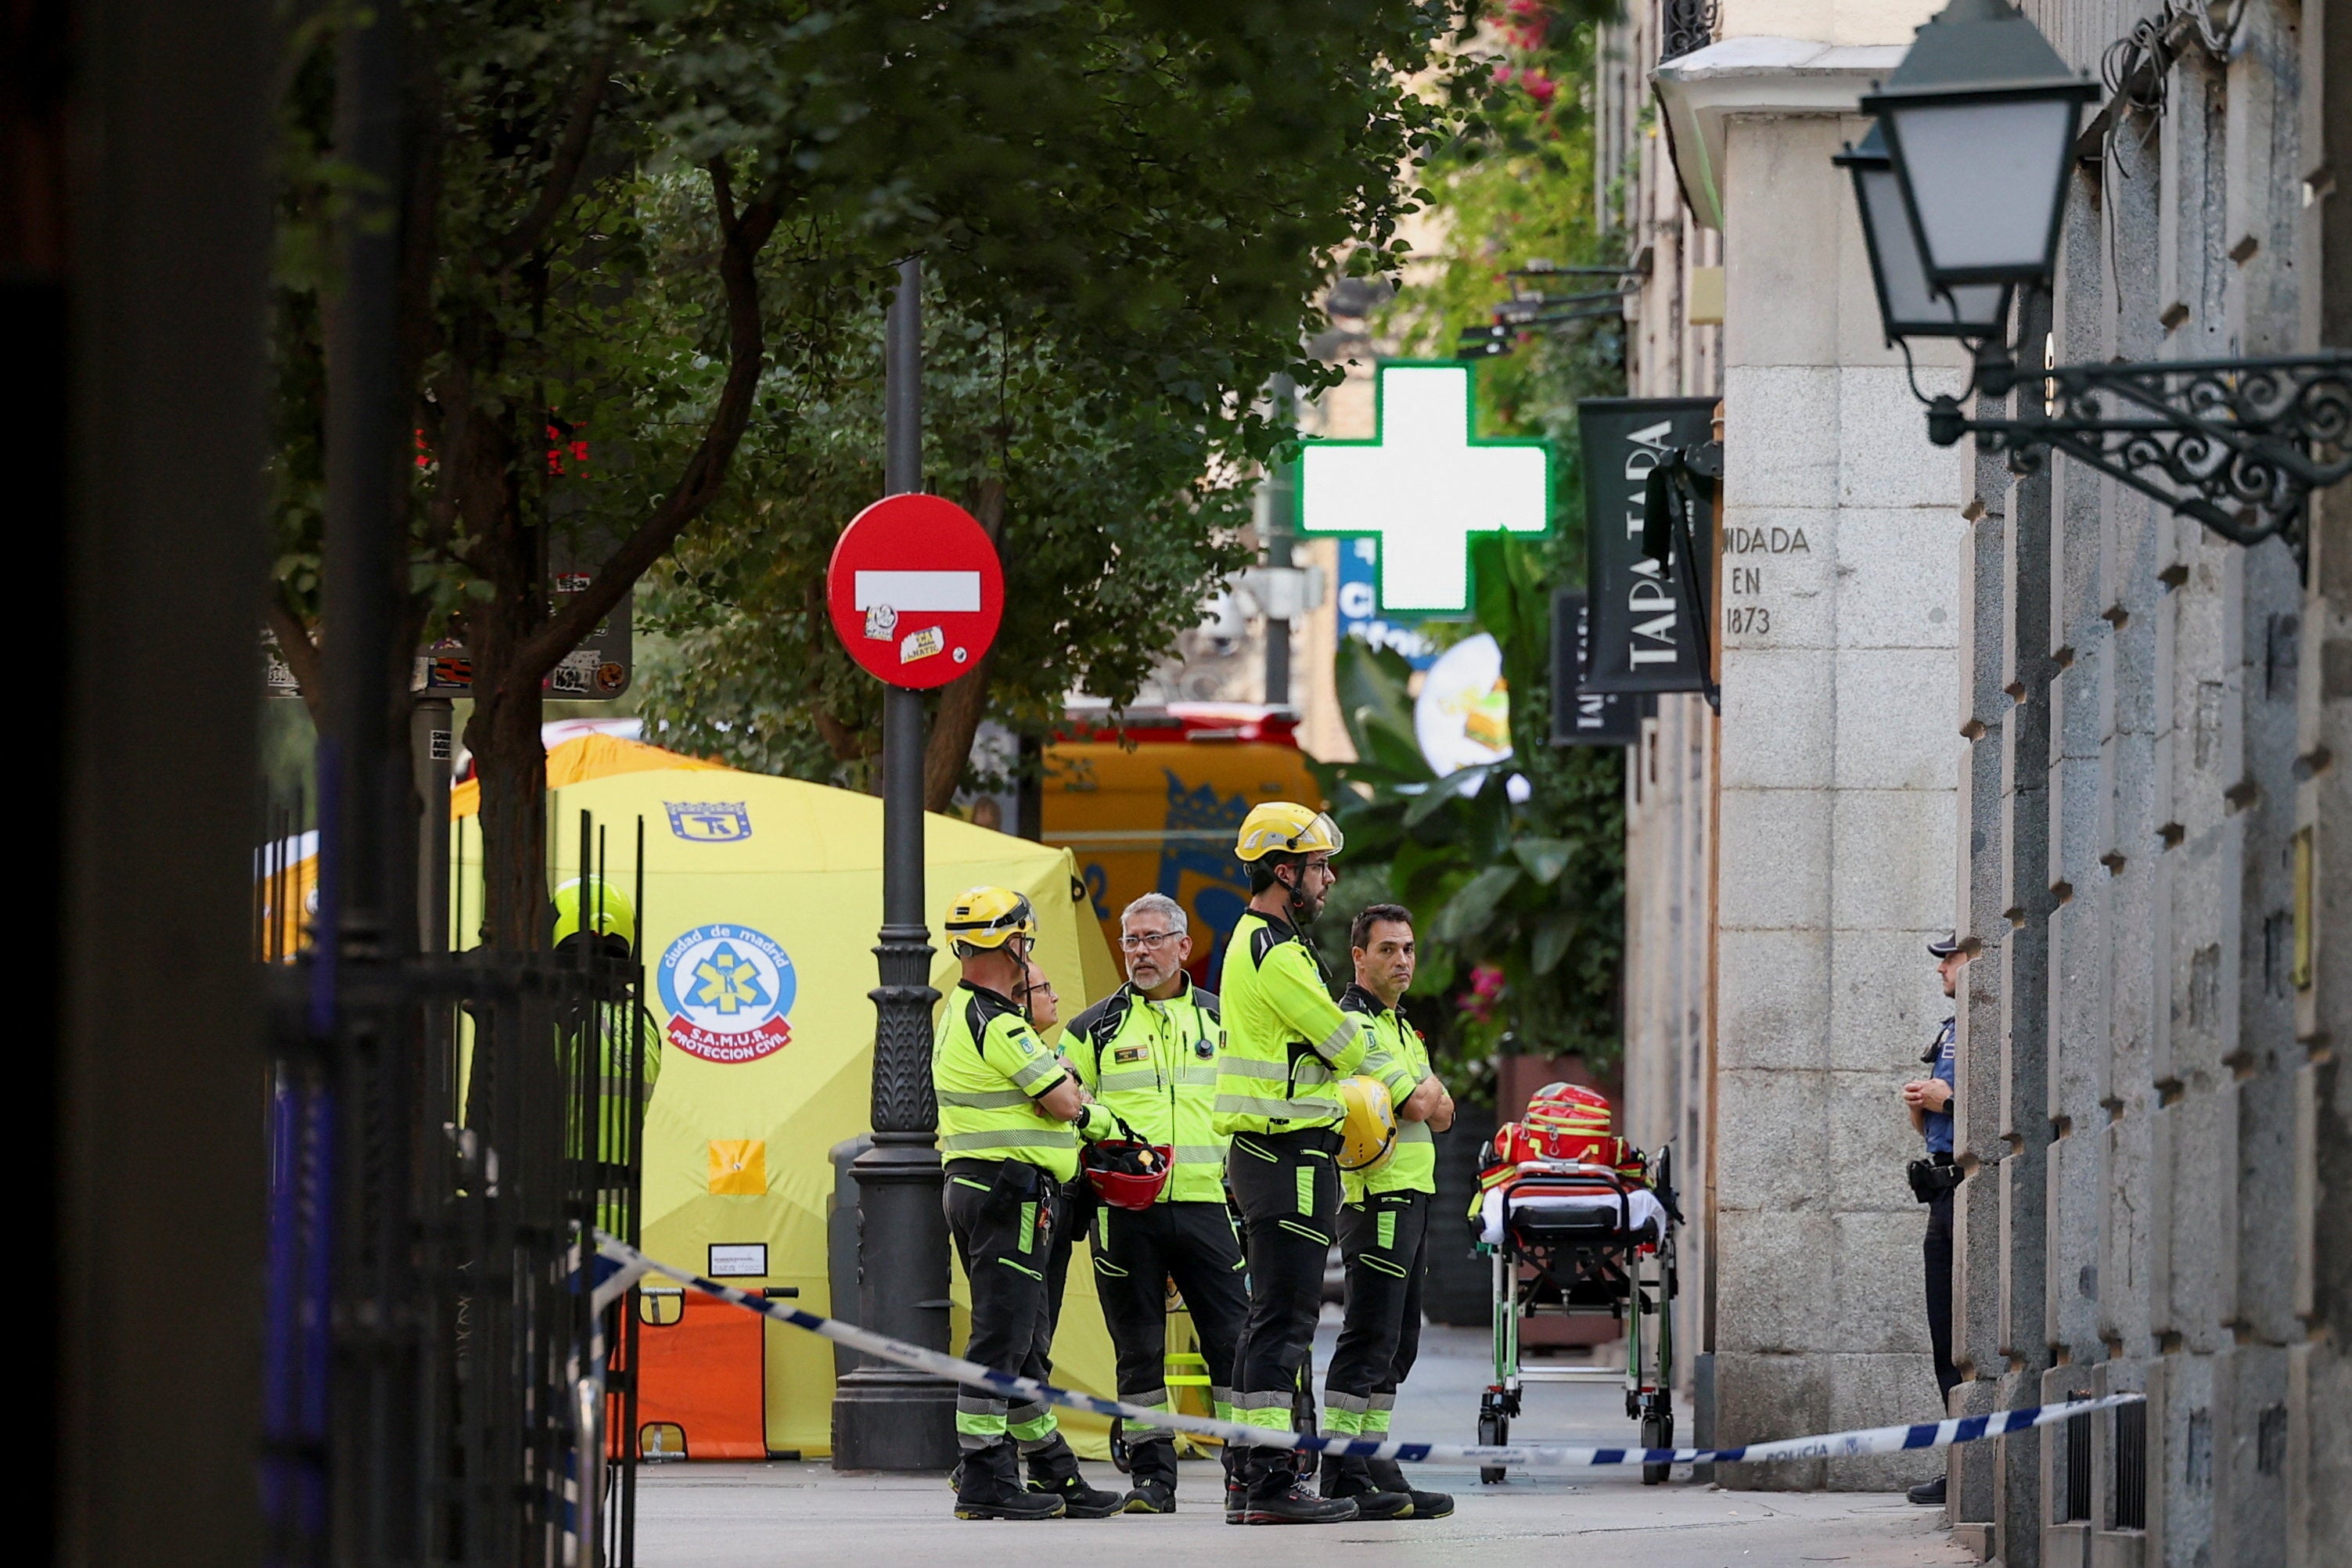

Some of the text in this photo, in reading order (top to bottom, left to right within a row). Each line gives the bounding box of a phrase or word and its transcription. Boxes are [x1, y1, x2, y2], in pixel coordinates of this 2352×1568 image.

[1721, 527, 1811, 554] NDADA
[1732, 566, 1760, 595] EN
[1628, 550, 1678, 673] TAPA
[1727, 606, 1771, 635] 1873
[665, 924, 789, 969] ciudad de madrid
[671, 1030, 787, 1060] PROTECCION CIVIL
[689, 1027, 769, 1047] S.A.M.U.R.
